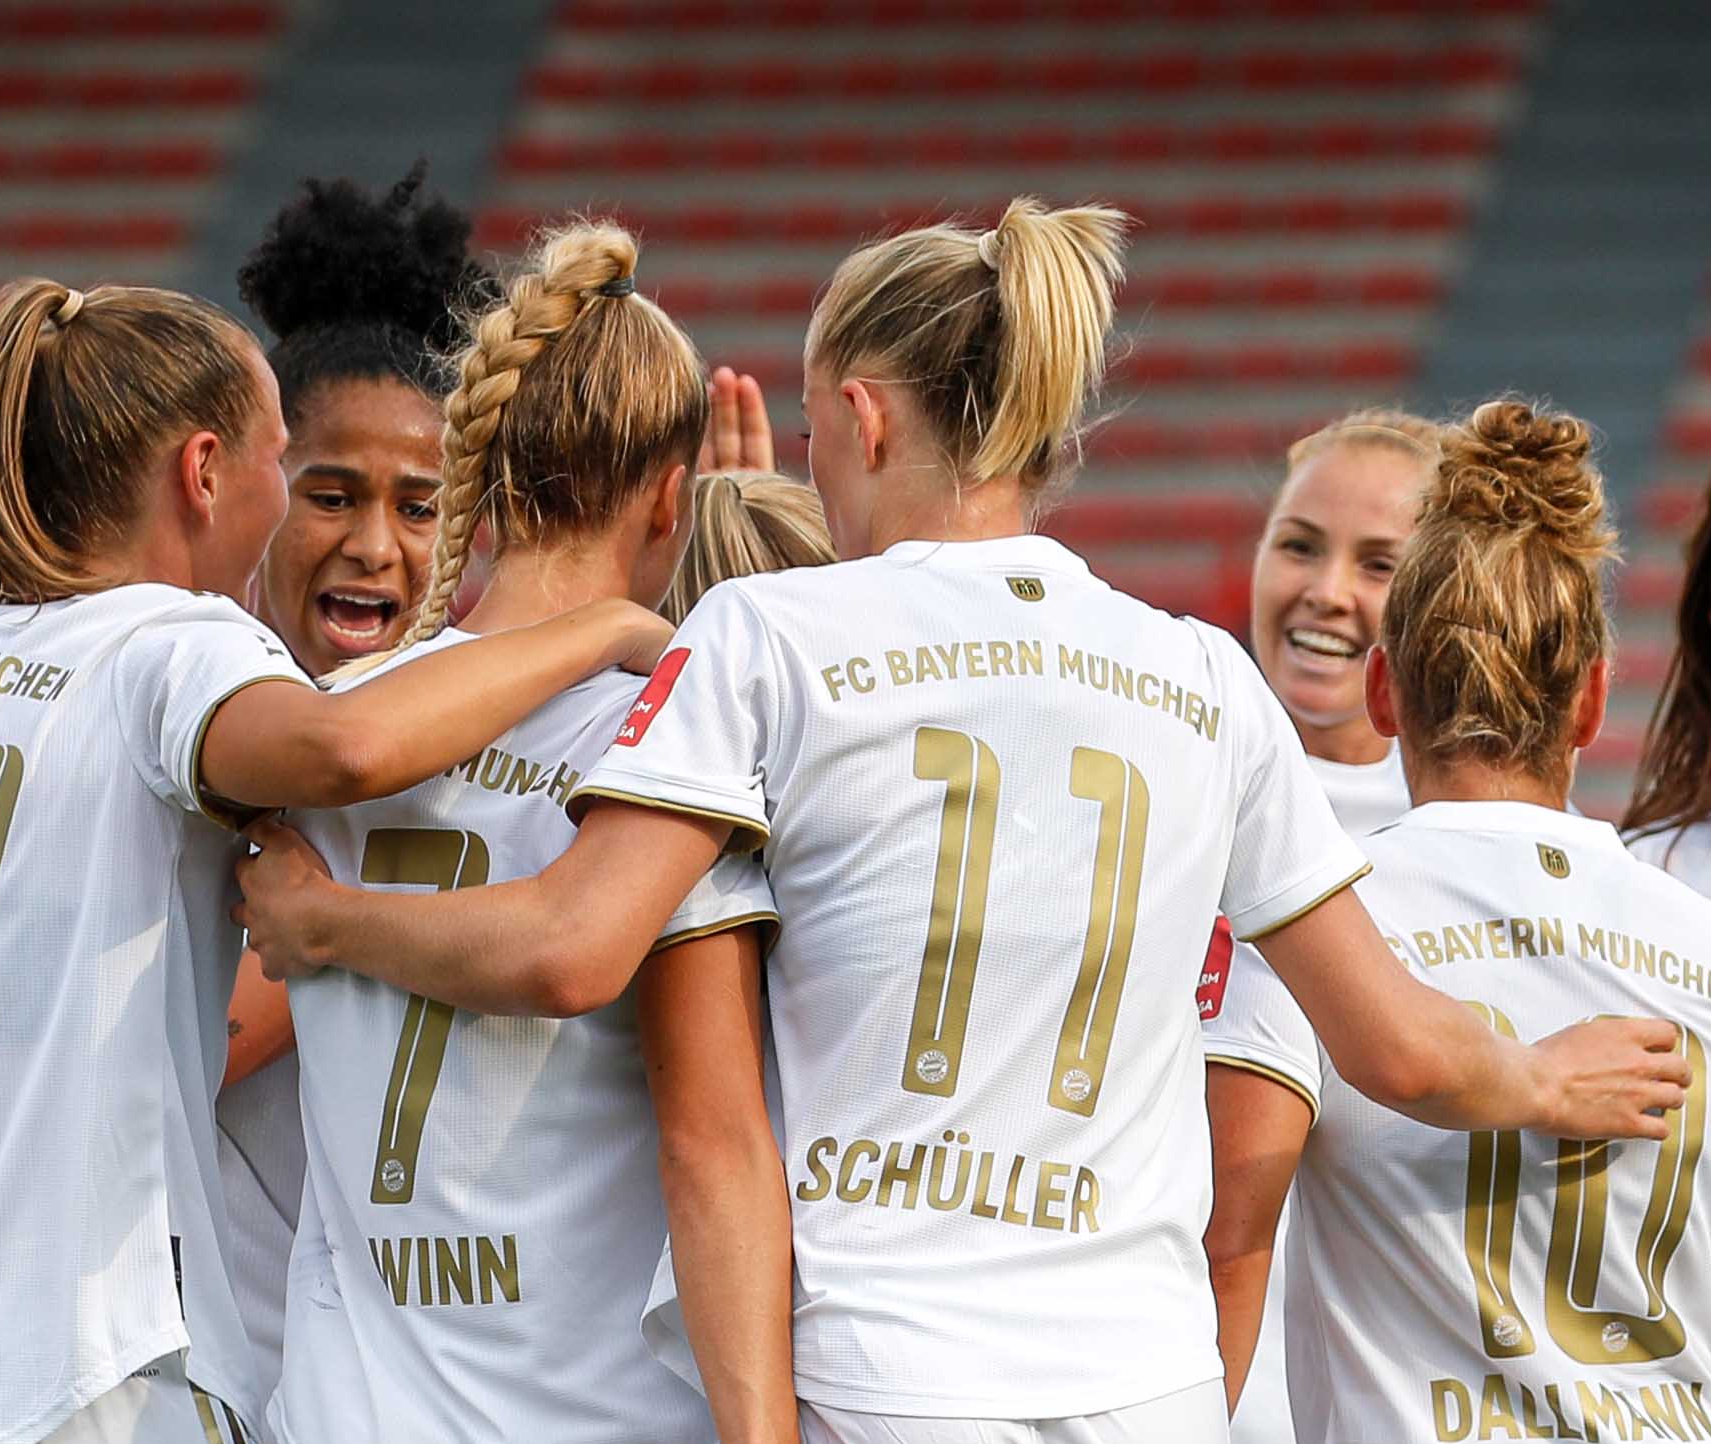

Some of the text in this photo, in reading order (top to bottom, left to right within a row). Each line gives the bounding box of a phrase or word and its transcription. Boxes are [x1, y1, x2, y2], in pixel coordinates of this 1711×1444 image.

[820, 639, 1222, 743] FC BAYERN MÜNCHEN
[901, 726, 1151, 1118] 11
[1413, 916, 1565, 969] BAYERN
[360, 827, 490, 1204] 7
[796, 1129, 1102, 1234] SCHÜLLER
[1457, 1000, 1707, 1364] 10
[368, 1233, 522, 1309] WINN
